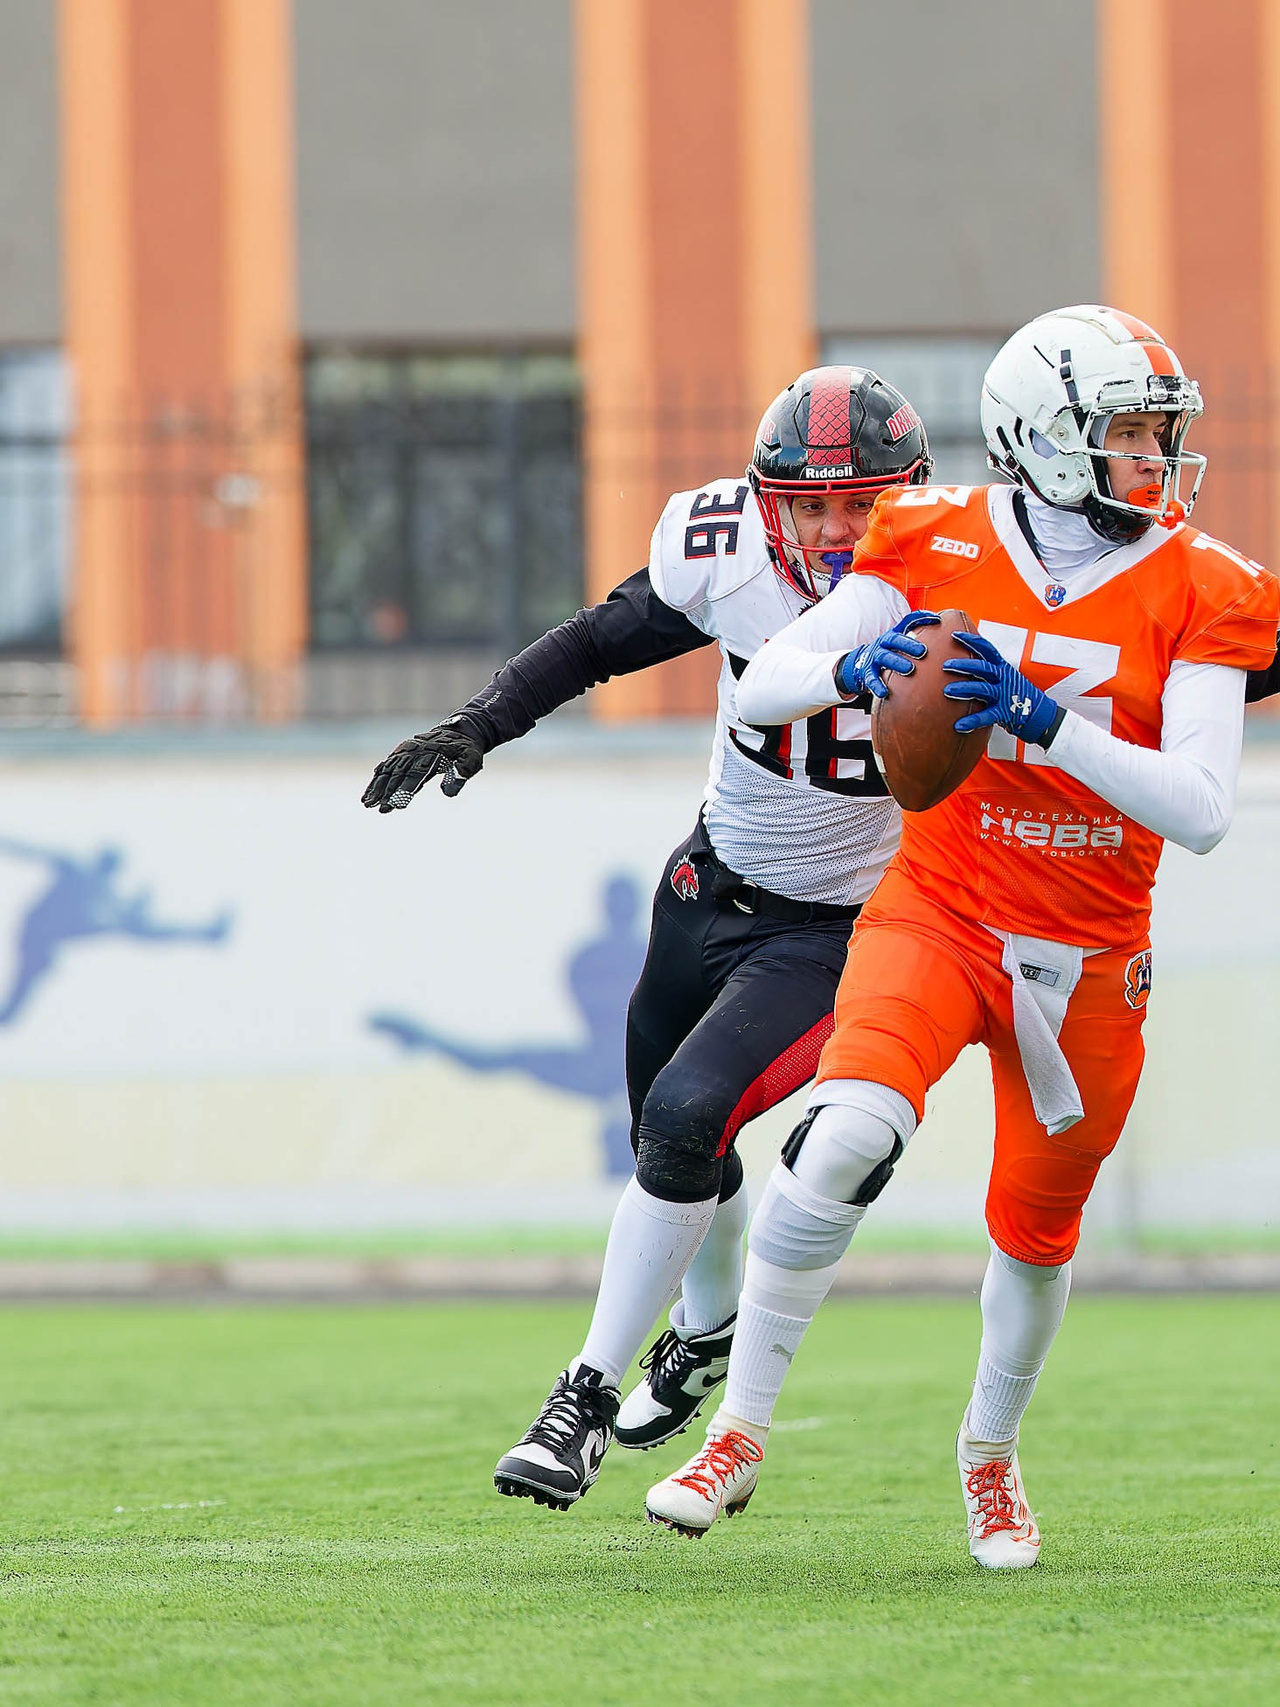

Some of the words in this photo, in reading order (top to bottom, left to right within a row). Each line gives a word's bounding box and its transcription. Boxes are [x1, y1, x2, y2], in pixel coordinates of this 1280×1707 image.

[805, 466, 853, 479] Riddell
[684, 485, 750, 560] 36
[930, 535, 980, 559] ZEDO
[980, 801, 1123, 825] МОТОТЕХНИКА
